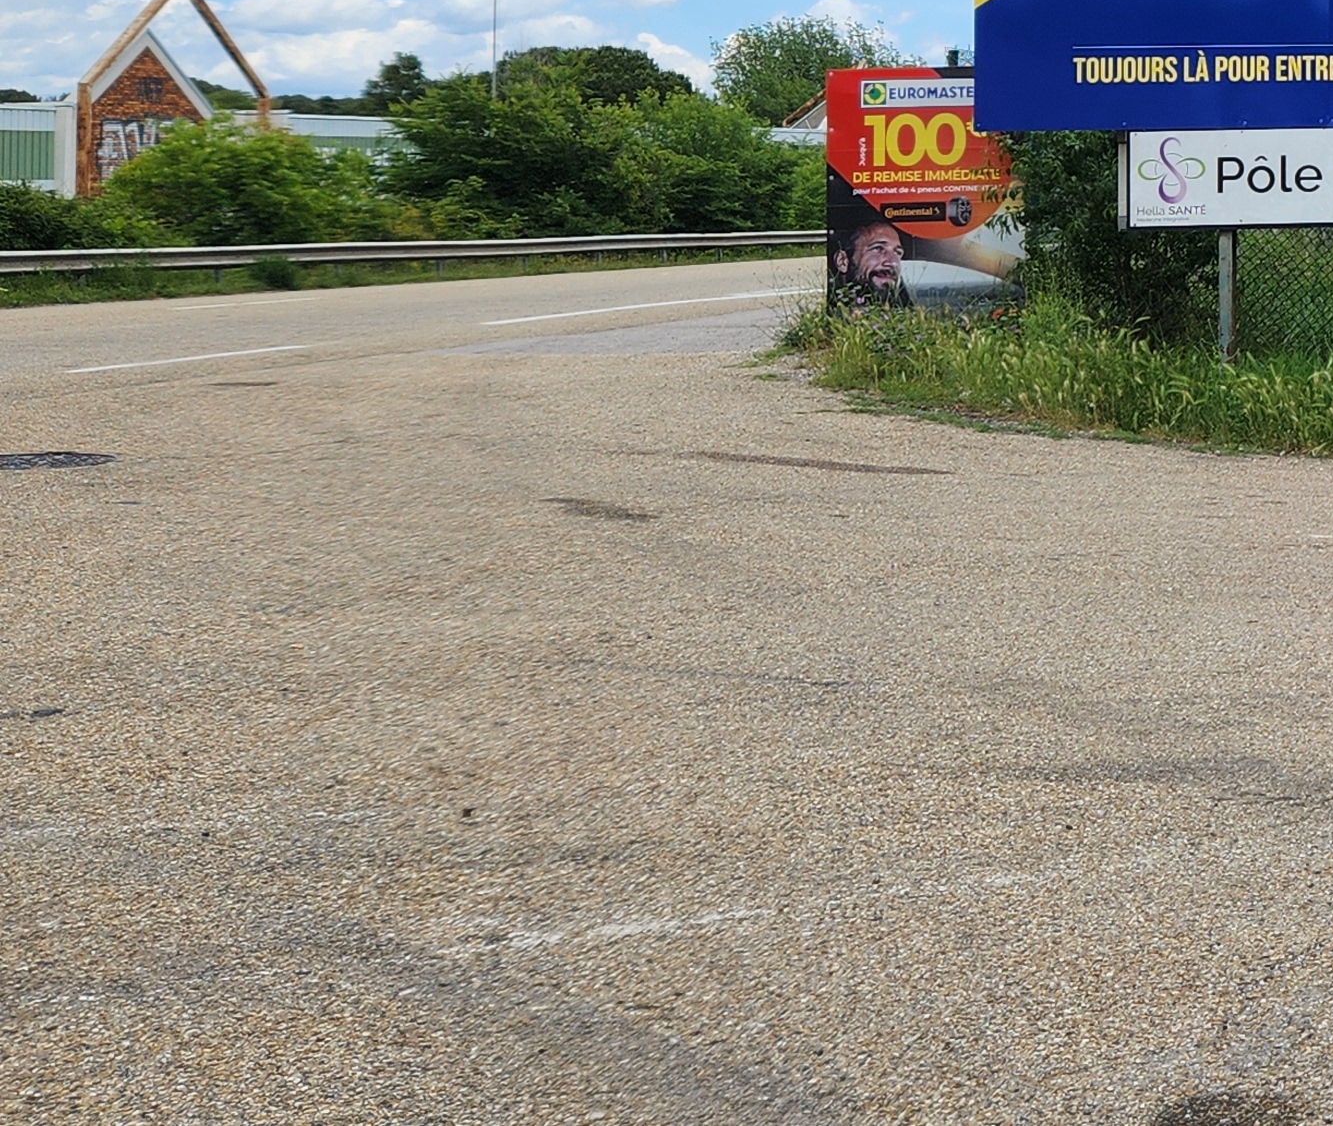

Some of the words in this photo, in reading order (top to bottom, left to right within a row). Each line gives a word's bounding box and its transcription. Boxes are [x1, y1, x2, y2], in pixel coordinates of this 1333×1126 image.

[1073, 55, 1178, 83] TOUJOURS
[1183, 49, 1208, 82] LÀ
[1215, 54, 1269, 82] POUR
[888, 85, 975, 100] EUROMASTE
[853, 171, 871, 184] DE
[873, 169, 923, 183] REMISE
[1216, 155, 1323, 194] Pôle
[899, 185, 909, 194] de
[910, 186, 916, 194] 4
[917, 186, 942, 195] pneus
[1136, 206, 1165, 217] Hella
[1168, 204, 1206, 216] SANTÉ
